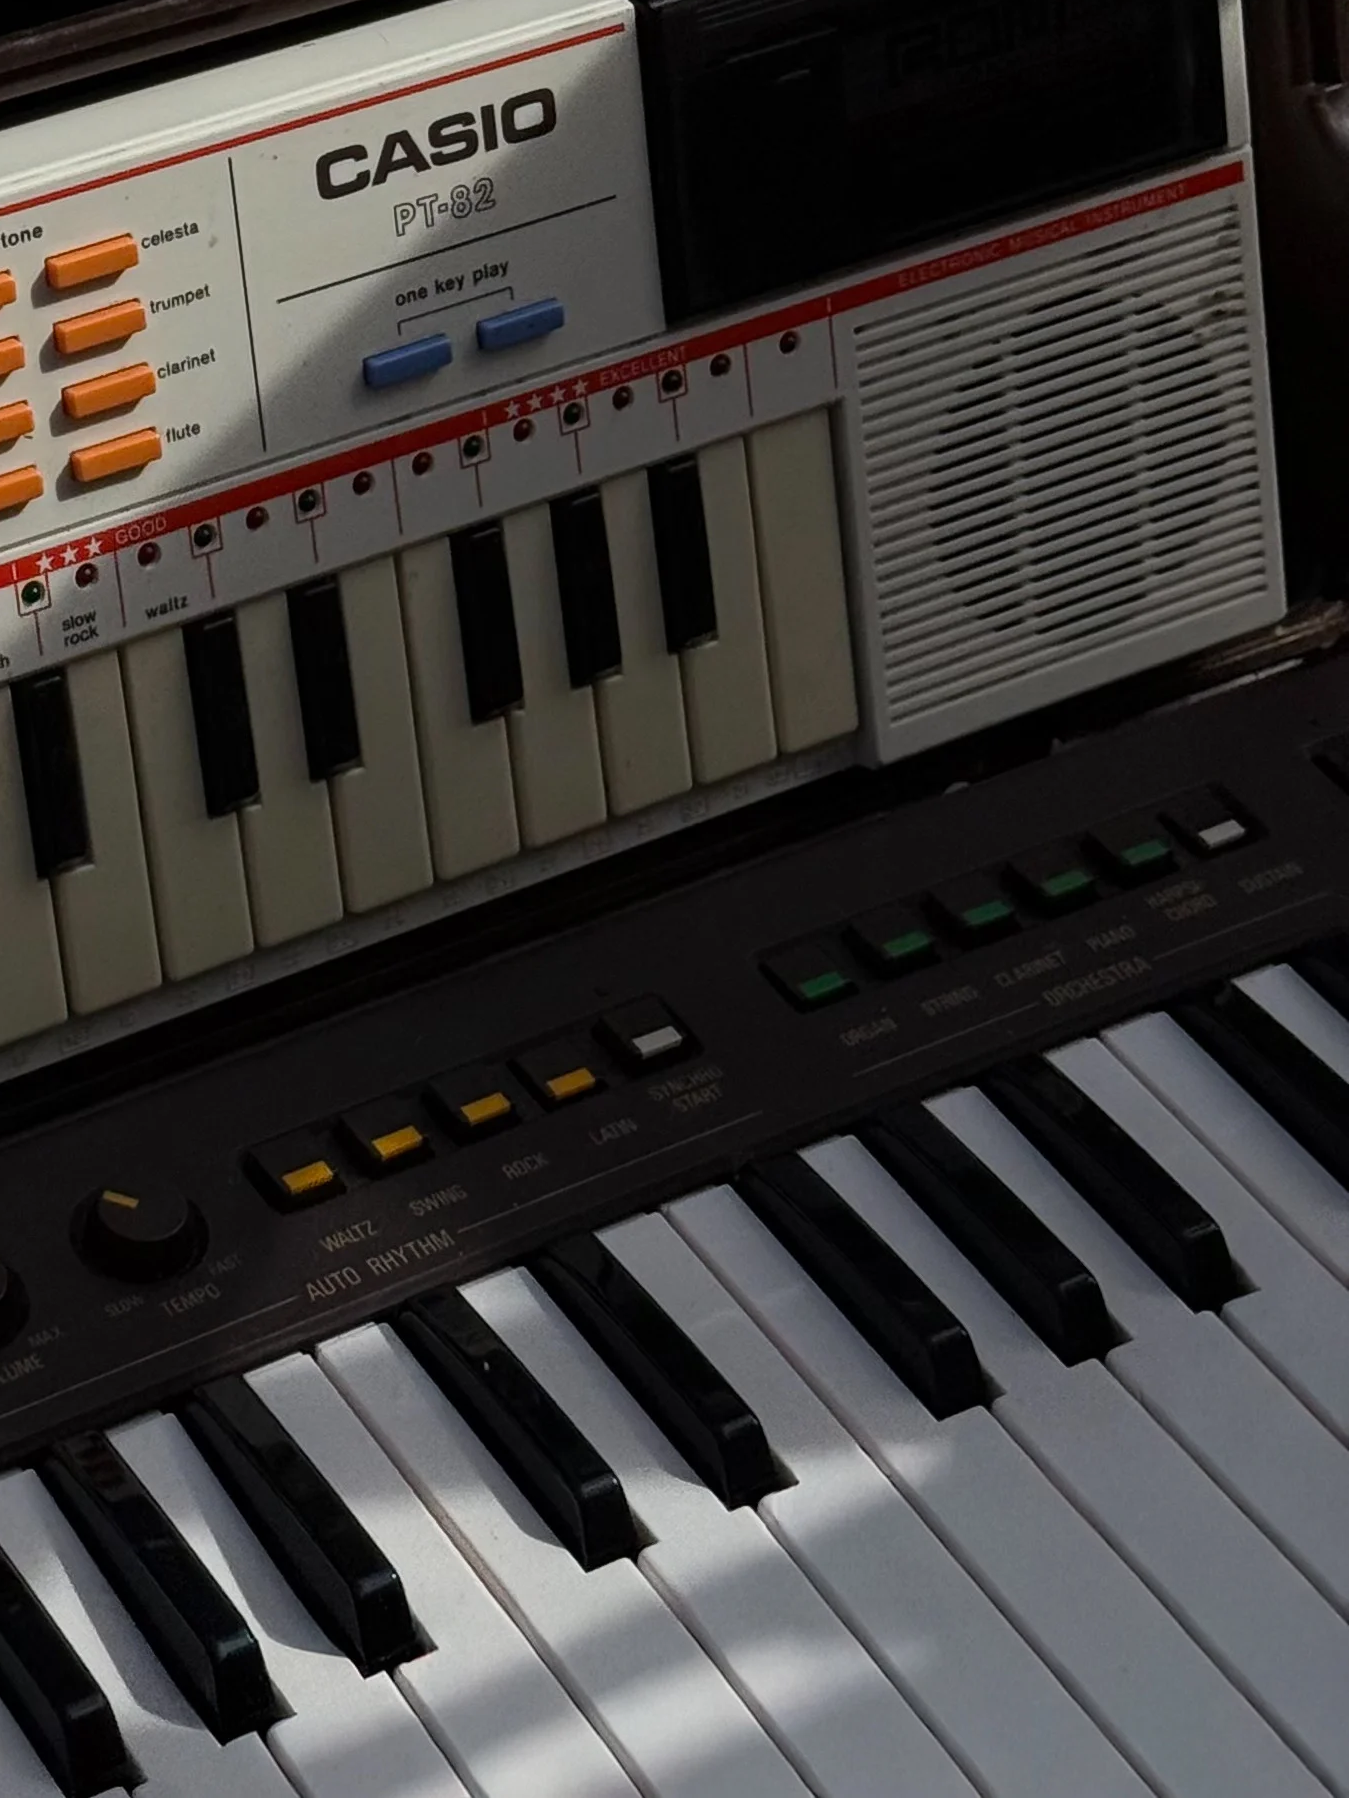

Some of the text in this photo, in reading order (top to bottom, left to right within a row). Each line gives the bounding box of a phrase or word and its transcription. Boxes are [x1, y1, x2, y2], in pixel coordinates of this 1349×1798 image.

[316, 87, 556, 200] CASIO
[393, 177, 496, 236] PT-82
[0, 225, 44, 248] tone
[141, 221, 199, 248] celesta
[395, 258, 509, 307] one key play
[150, 285, 210, 315] trumpet
[156, 349, 216, 379] clarinet
[598, 346, 687, 387] EXCELLENT
[165, 421, 201, 443] flute
[115, 516, 167, 544] GOOD
[61, 610, 97, 632] slow
[145, 594, 188, 619] waltz
[63, 625, 99, 647] rock
[1042, 956, 1151, 1008] ORCHESTRA
[672, 1085, 723, 1112] START
[588, 1117, 638, 1145] LATIN
[502, 1153, 548, 1180] ROCK
[409, 1185, 467, 1217] SWING
[319, 1220, 377, 1253] WALTZ
[305, 1229, 455, 1302] AUTO RHYTHM
[161, 1283, 221, 1317] TEMPO
